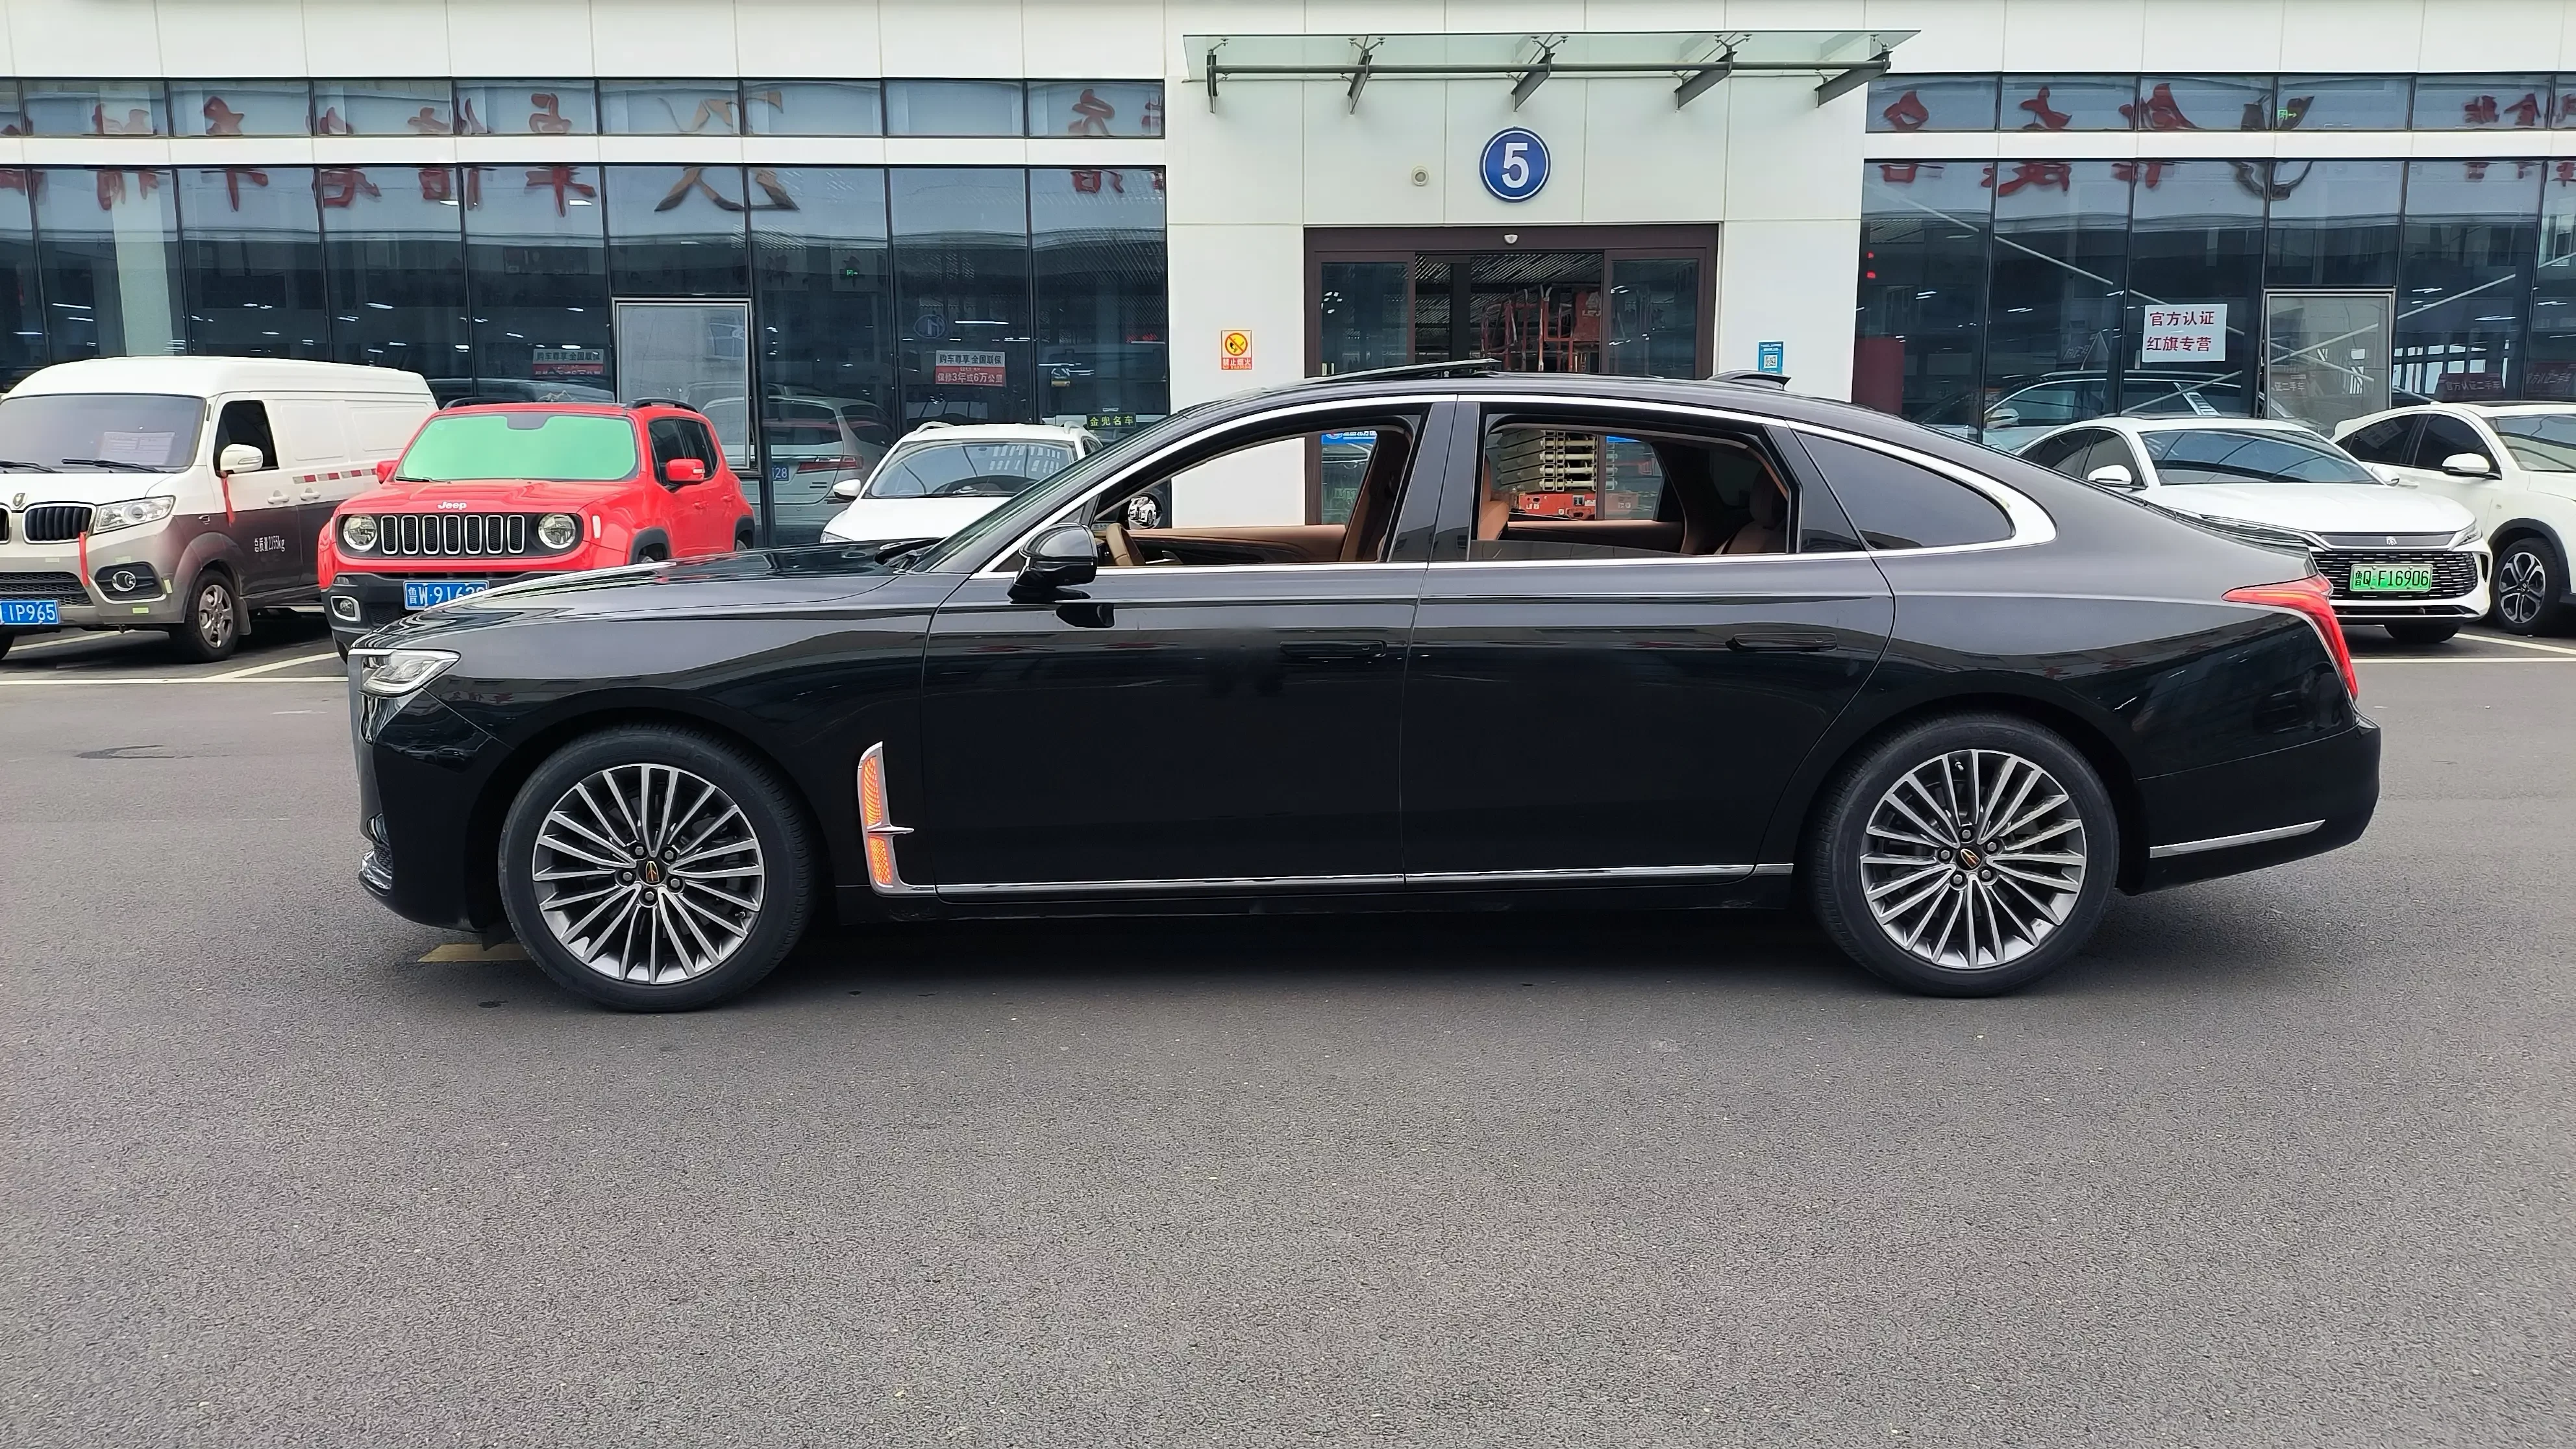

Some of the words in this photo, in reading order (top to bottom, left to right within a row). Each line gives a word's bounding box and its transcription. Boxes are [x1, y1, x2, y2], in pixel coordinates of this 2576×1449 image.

[1502, 142, 1530, 188] 5
[2149, 311, 2215, 327] 官方认证
[2146, 336, 2212, 352] 红旗专营
[438, 501, 467, 510] Jeep
